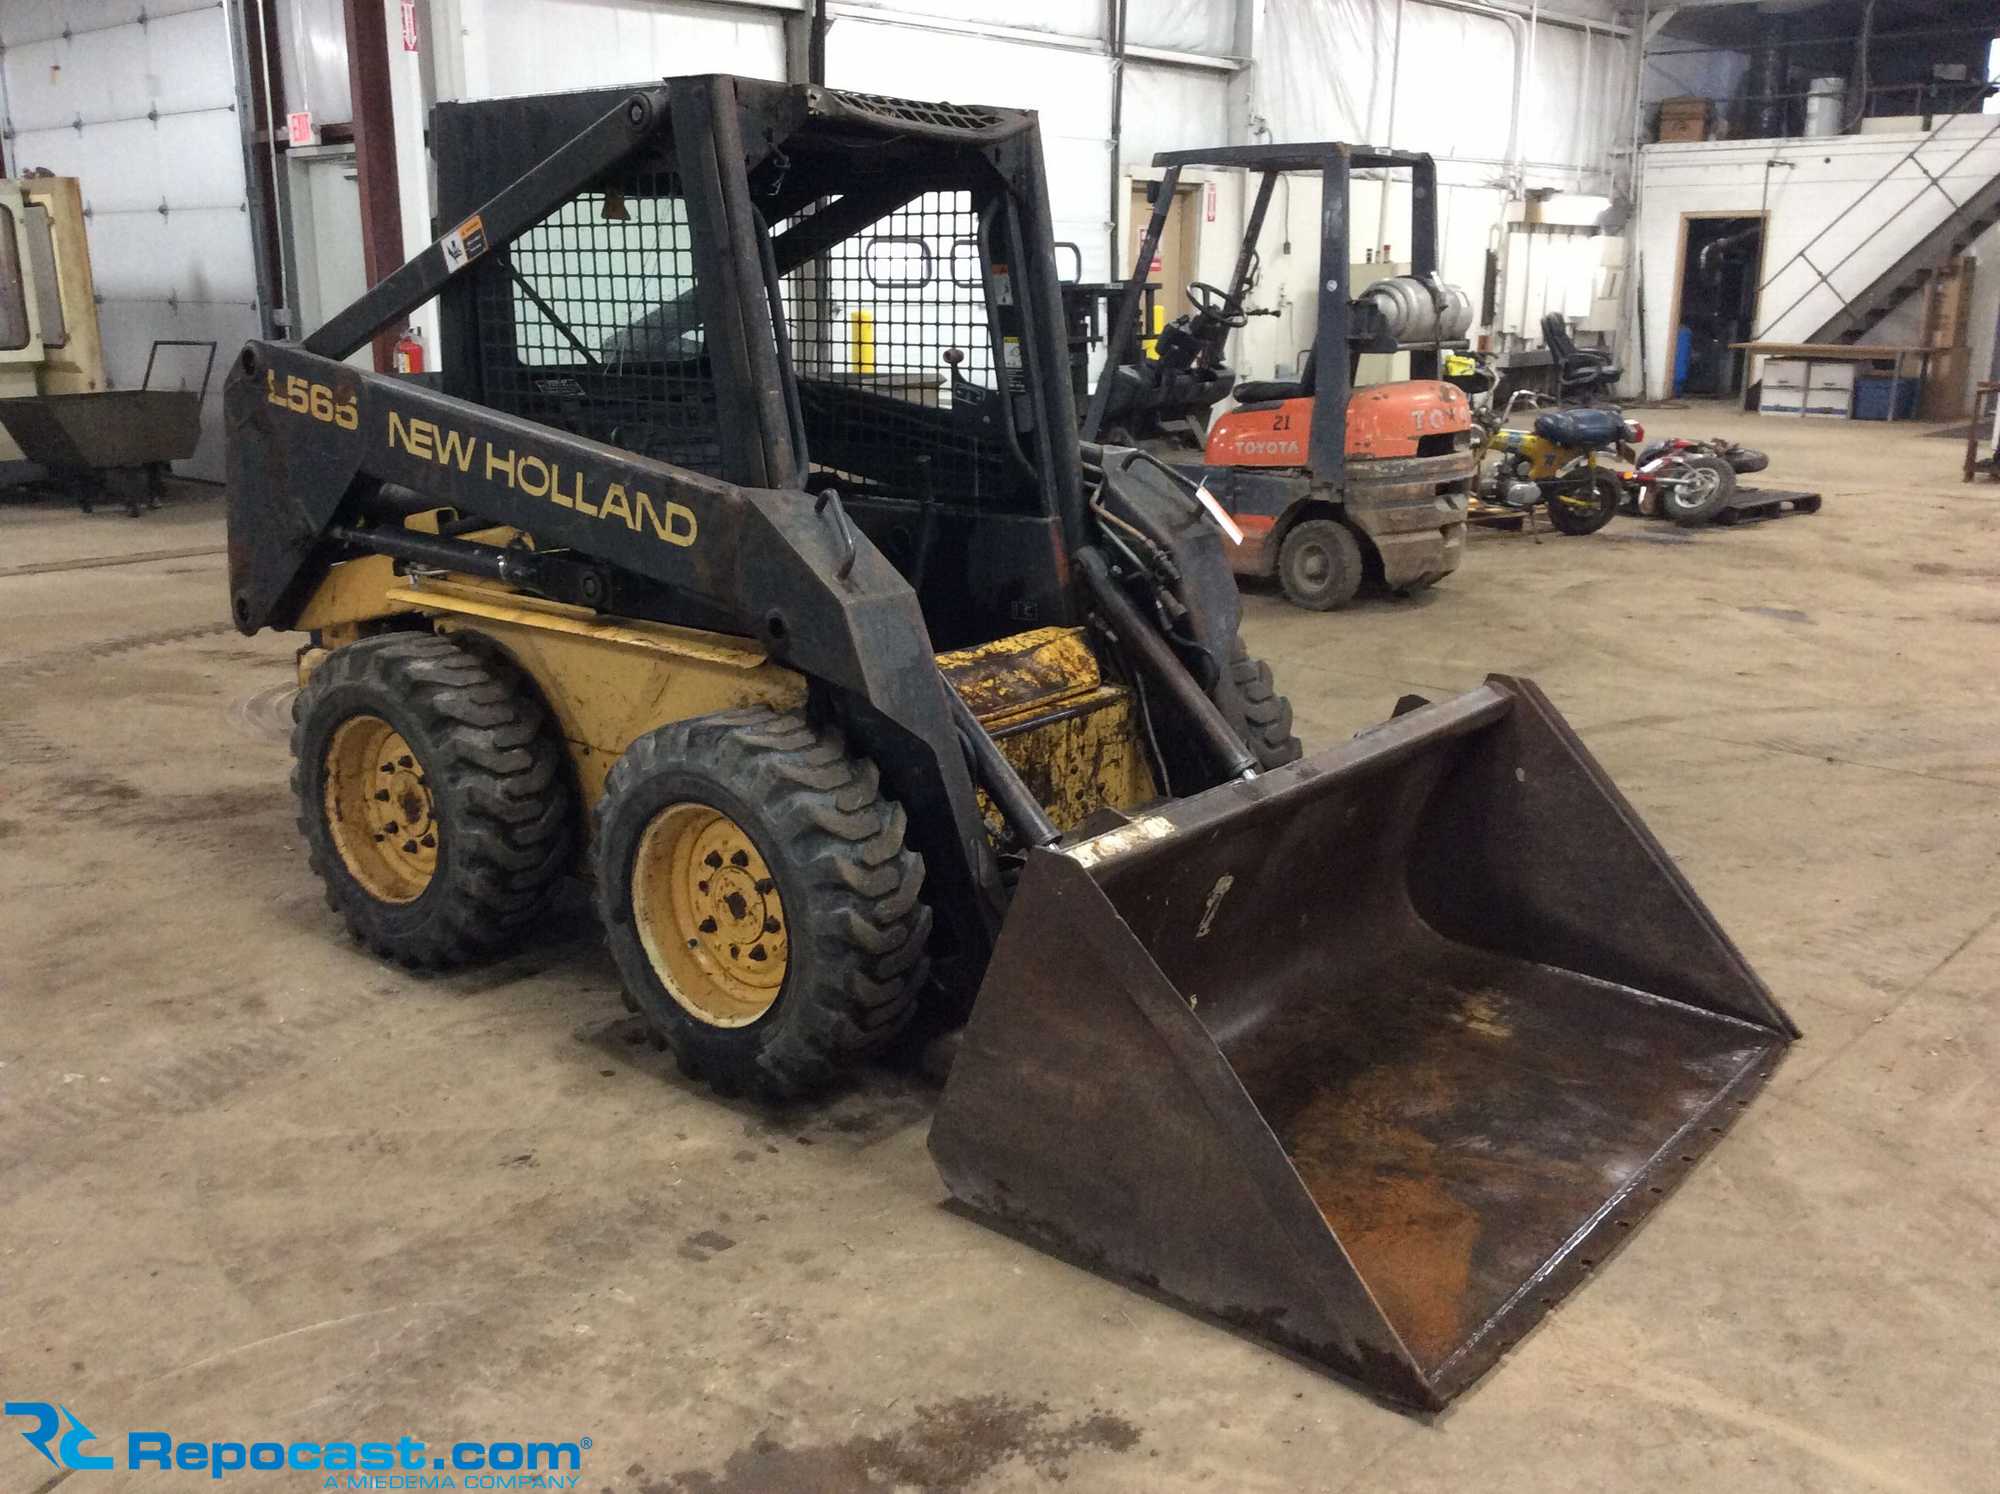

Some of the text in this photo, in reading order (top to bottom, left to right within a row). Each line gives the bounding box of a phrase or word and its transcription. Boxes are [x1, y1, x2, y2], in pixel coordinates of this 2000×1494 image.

[1272, 415, 1291, 432] 21
[1233, 440, 1300, 455] TOYOTA
[388, 410, 698, 547] NEW HOLLAND
